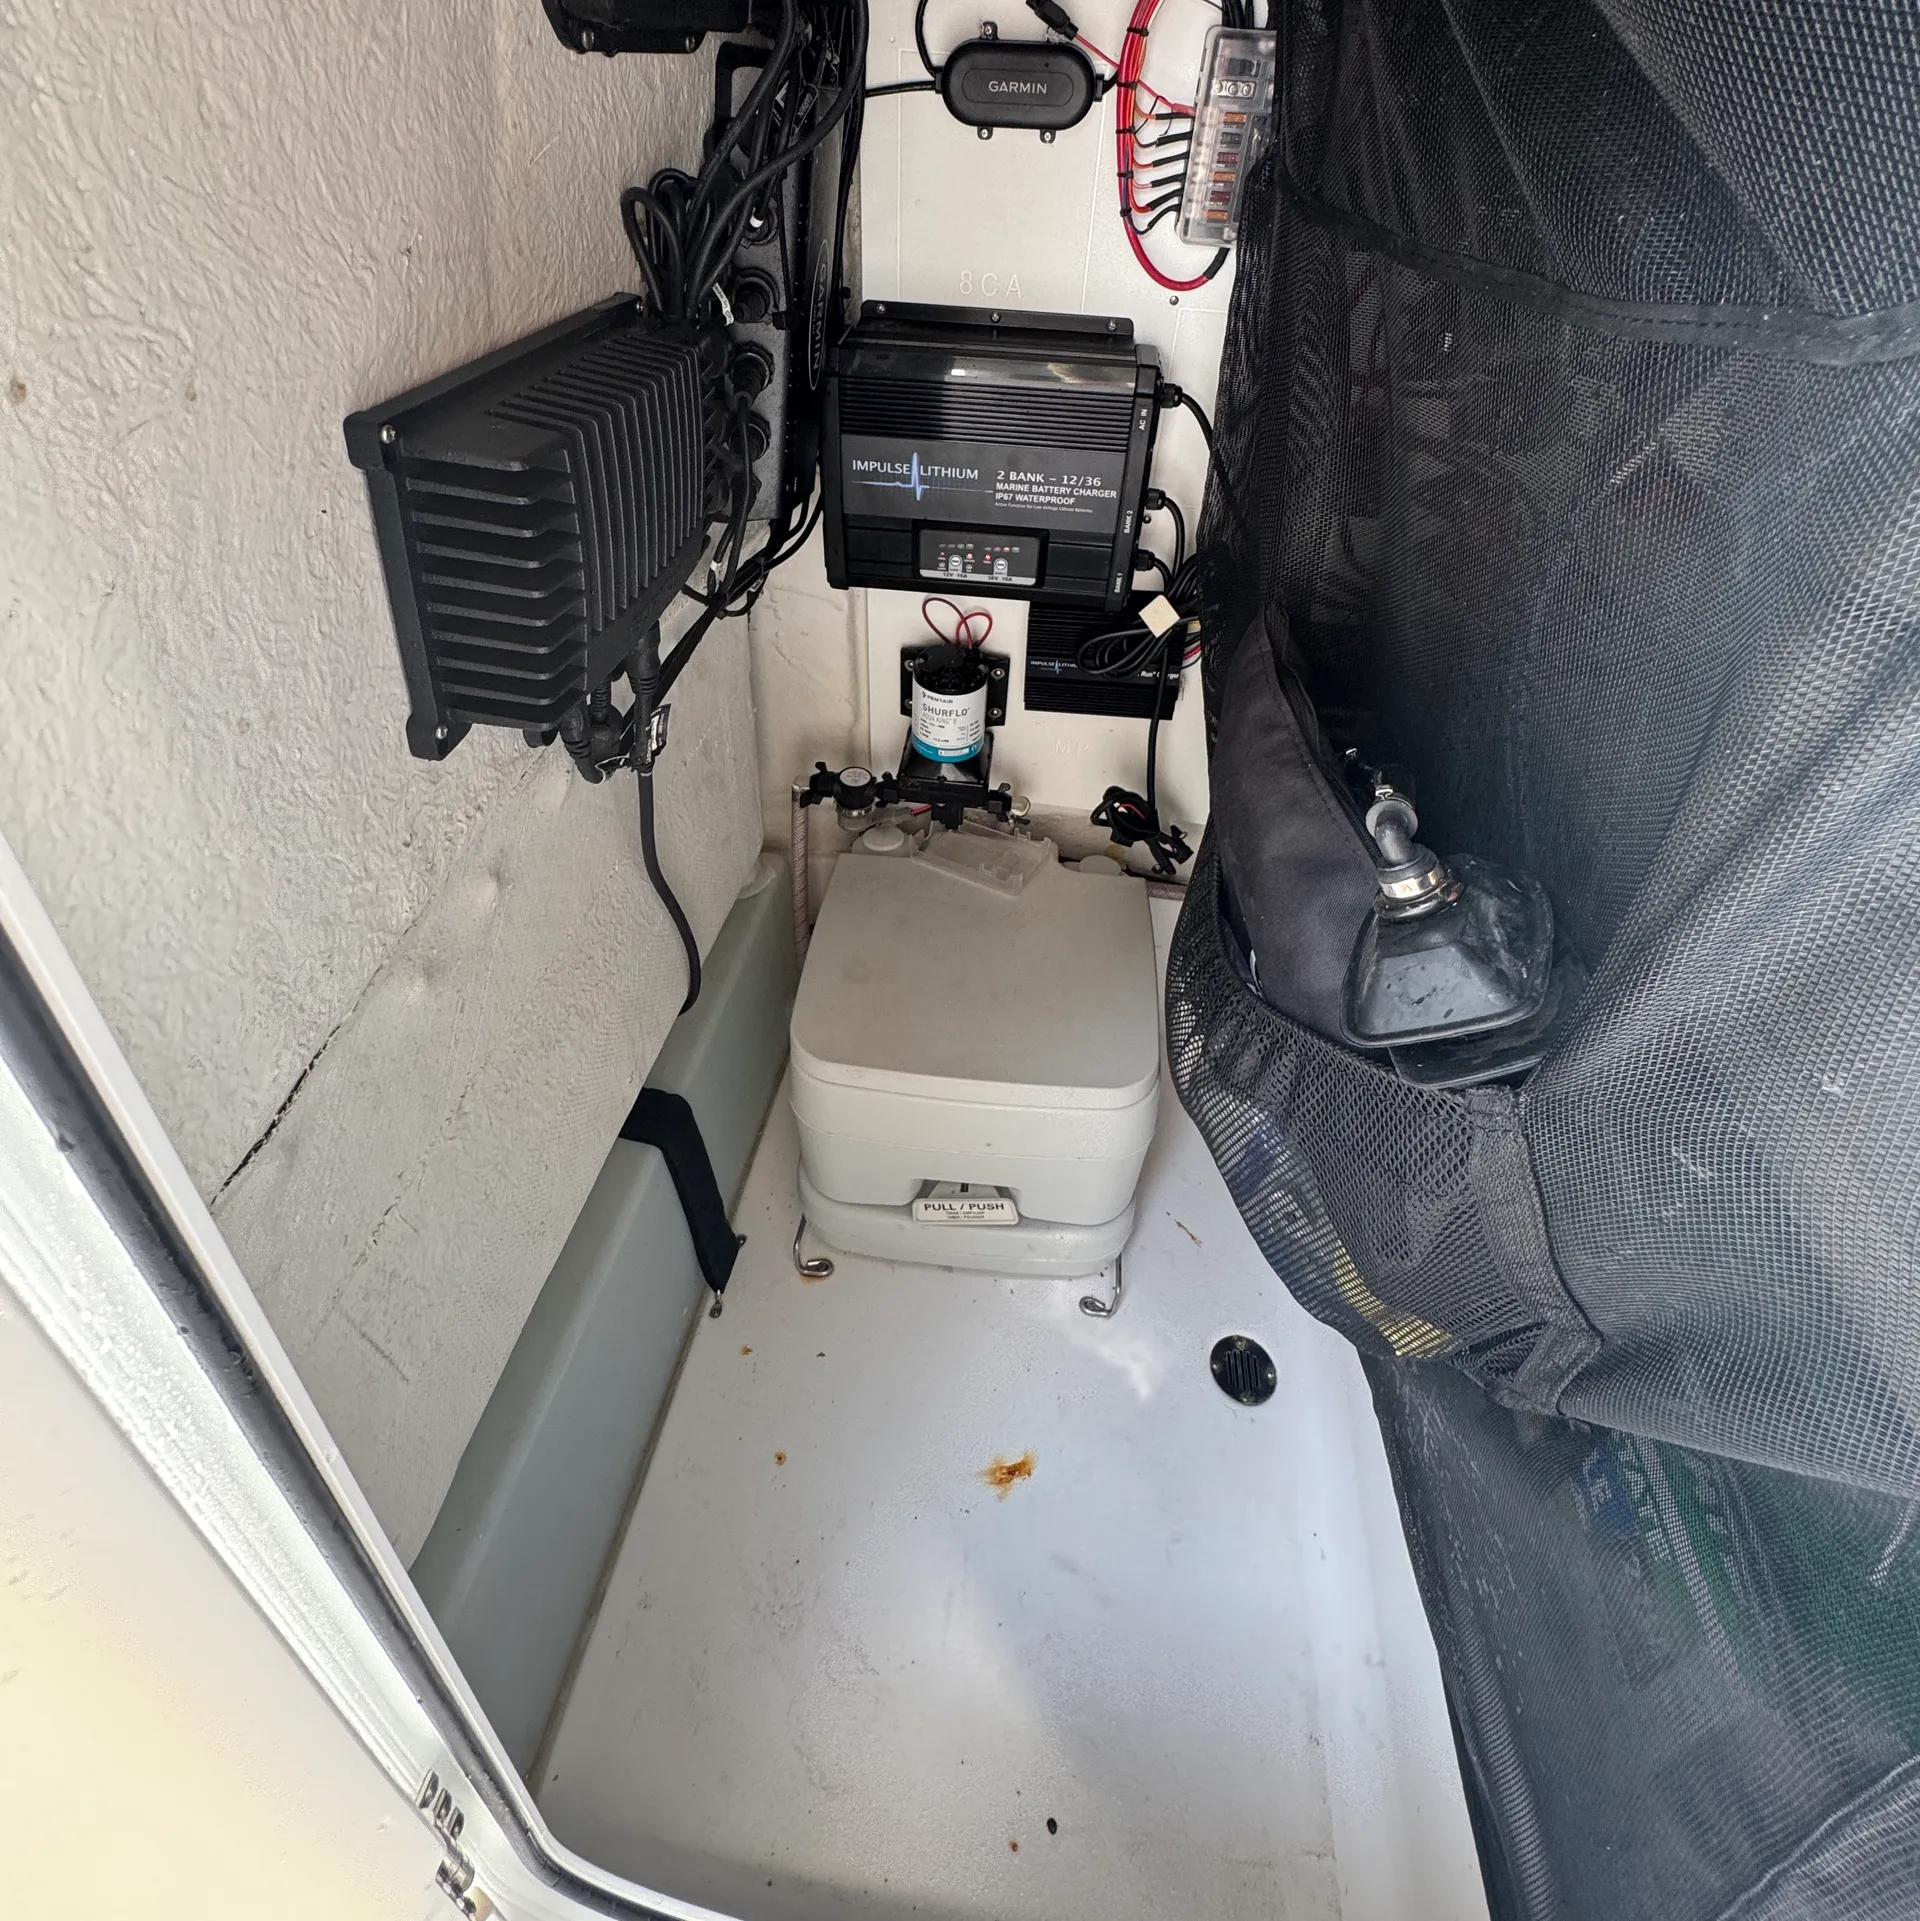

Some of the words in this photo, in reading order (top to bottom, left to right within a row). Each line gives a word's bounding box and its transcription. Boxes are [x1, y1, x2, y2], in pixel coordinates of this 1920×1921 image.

[988, 80, 1047, 95] GARMIN
[812, 263, 827, 370] GARMIN
[1140, 408, 1148, 417] IN
[1138, 419, 1146, 431] AC
[852, 459, 911, 475] IMPULSE
[920, 465, 979, 480] LITHIUM
[996, 470, 1005, 480] 2
[1009, 471, 1045, 483] BANK
[1062, 475, 1102, 487] 12/36
[995, 482, 1030, 492] MARINE
[1031, 484, 1072, 495] BATTERY
[1073, 487, 1117, 499] CHARGER
[995, 492, 1013, 501] IP67
[1015, 493, 1076, 506] WATERPROOF
[1123, 517, 1132, 534] BANK
[1114, 577, 1122, 593] BANK
[926, 695, 953, 704] PENTAIR
[924, 1203, 957, 1211] PULL
[969, 1203, 1005, 1211] PUSH
